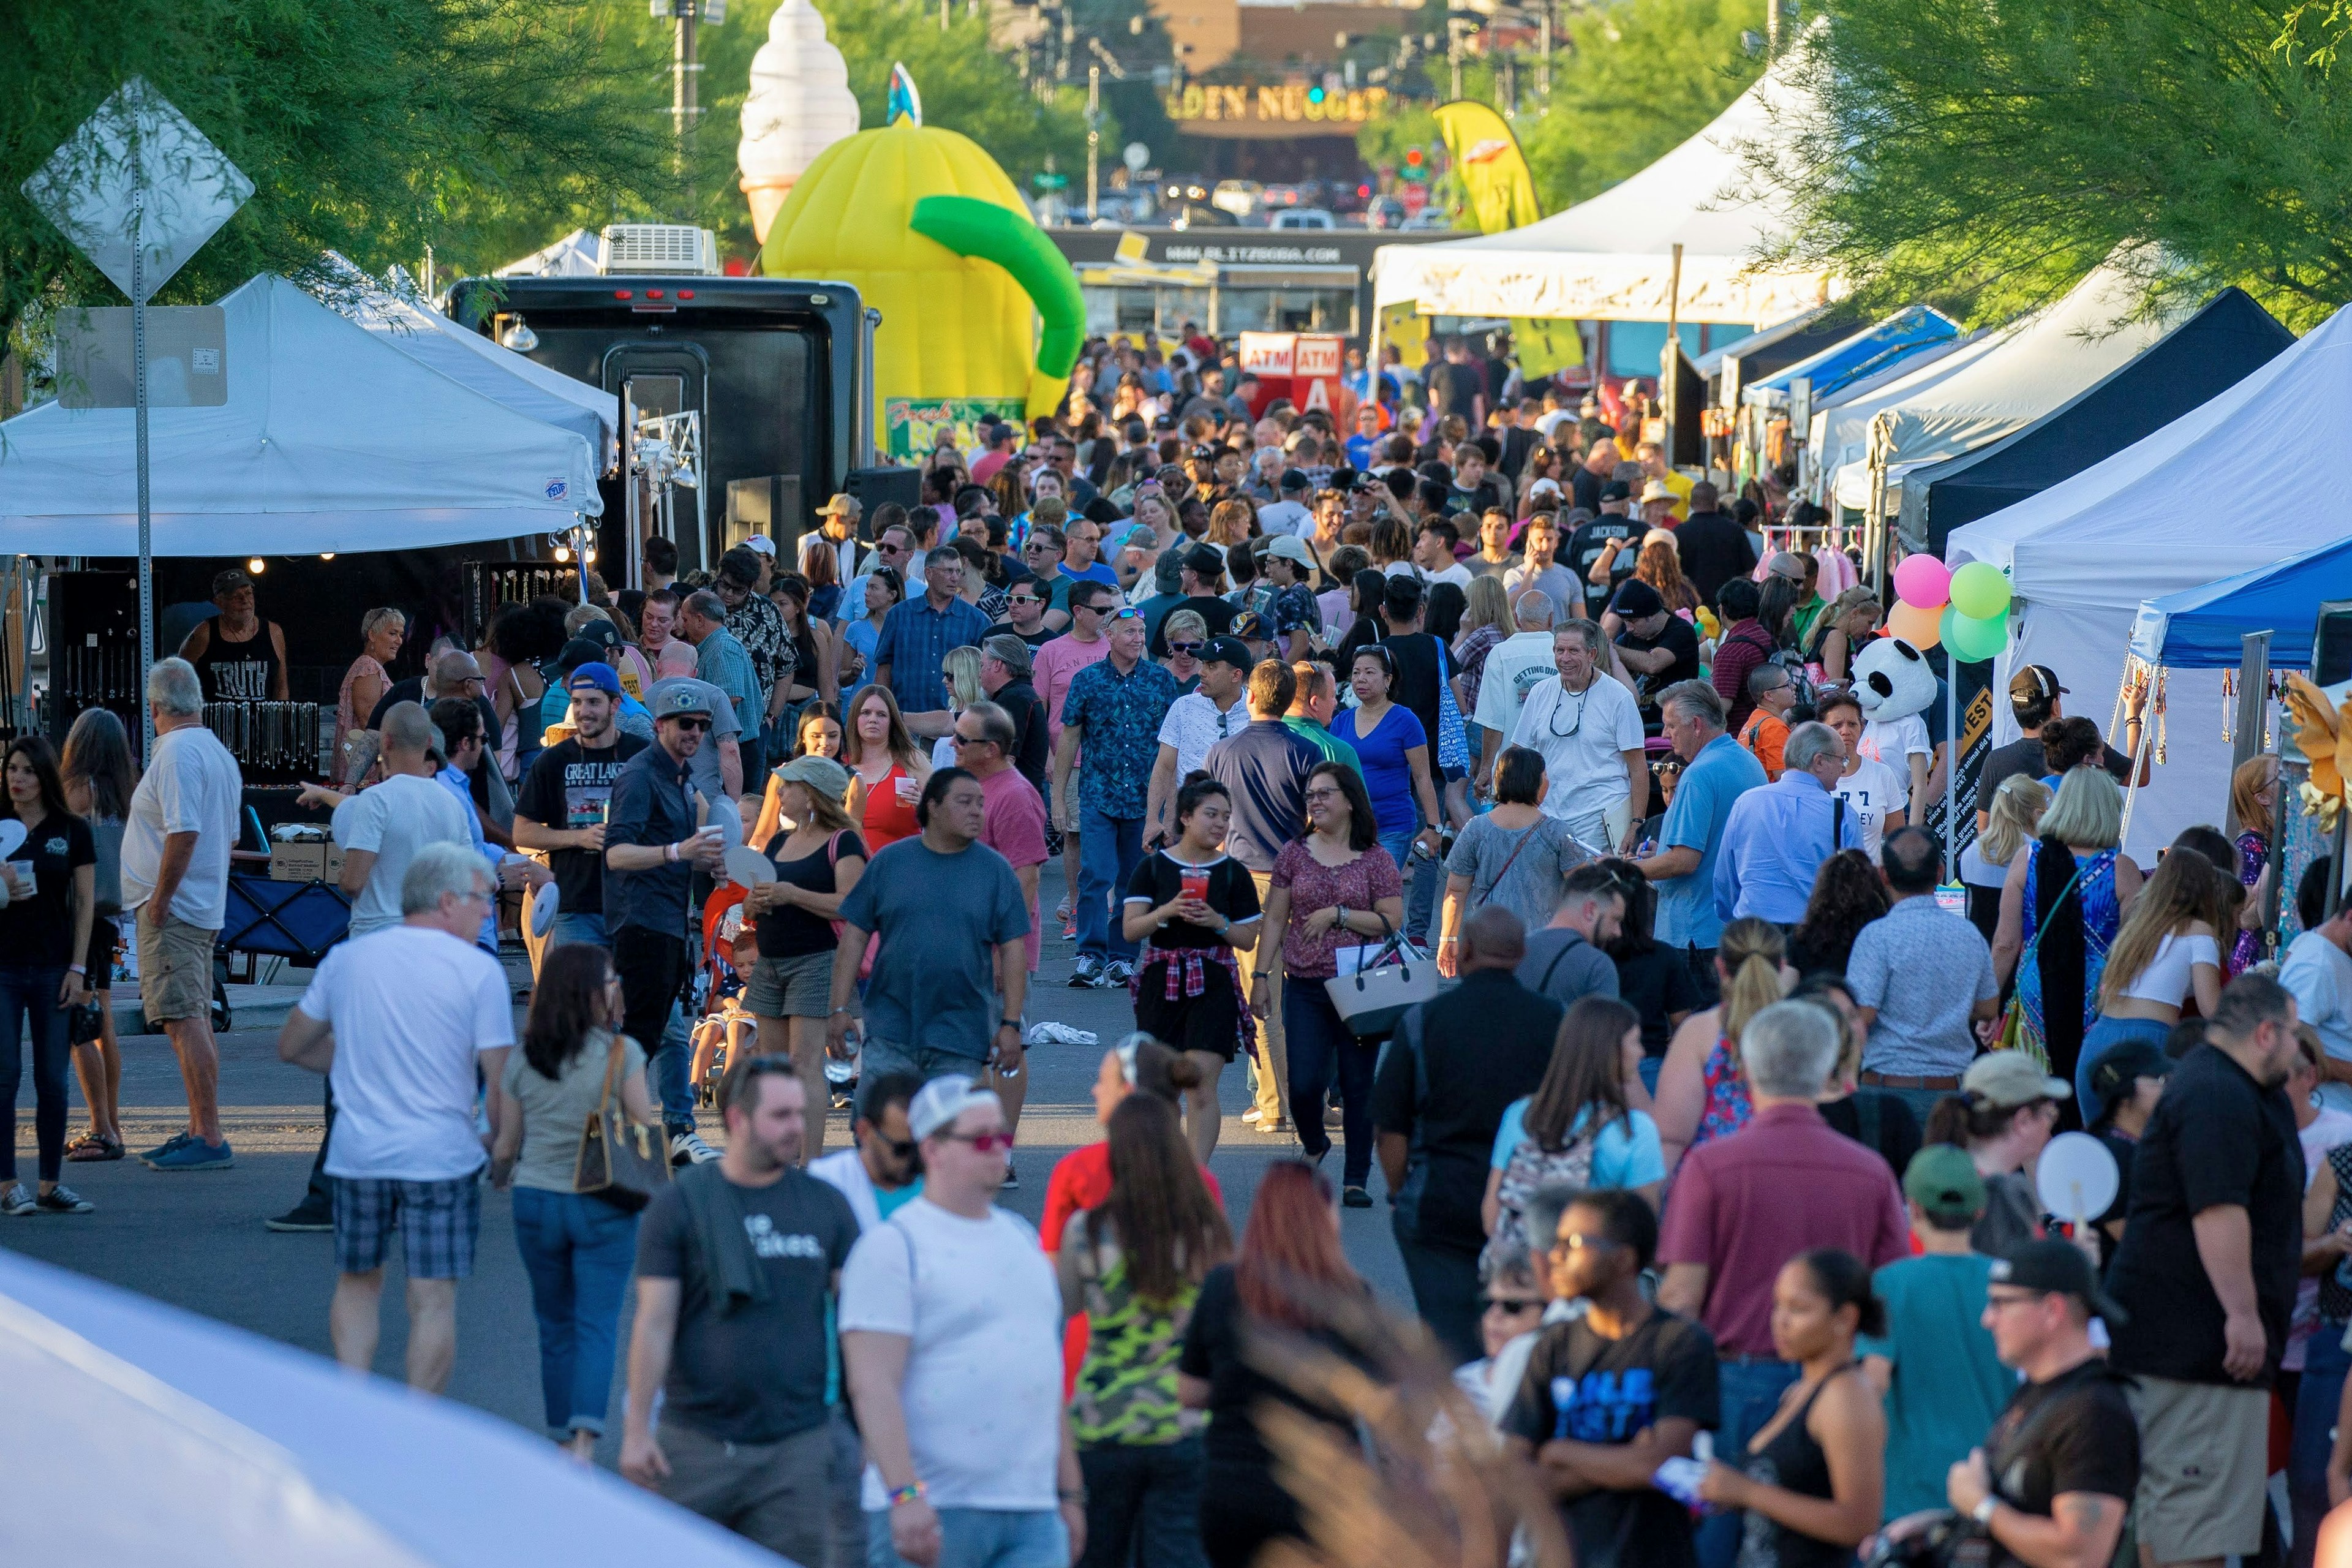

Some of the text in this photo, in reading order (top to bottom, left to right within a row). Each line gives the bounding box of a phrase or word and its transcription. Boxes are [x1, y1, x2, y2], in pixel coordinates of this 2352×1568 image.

[1250, 351, 1289, 366] ATM
[1300, 352, 1336, 367] ATM
[890, 400, 952, 429] Fresh
[1589, 526, 1629, 539] JACKSON
[210, 661, 268, 696] TRUTH
[1513, 666, 1544, 684] GETTING
[1964, 748, 1980, 769] animal
[1979, 738, 1988, 750] did
[565, 763, 598, 780] GREAT
[1927, 808, 1942, 825] place
[1955, 775, 1967, 790] ark?
[1961, 786, 1975, 804] name
[1961, 794, 1978, 816] people
[1954, 827, 1975, 855] sentence
